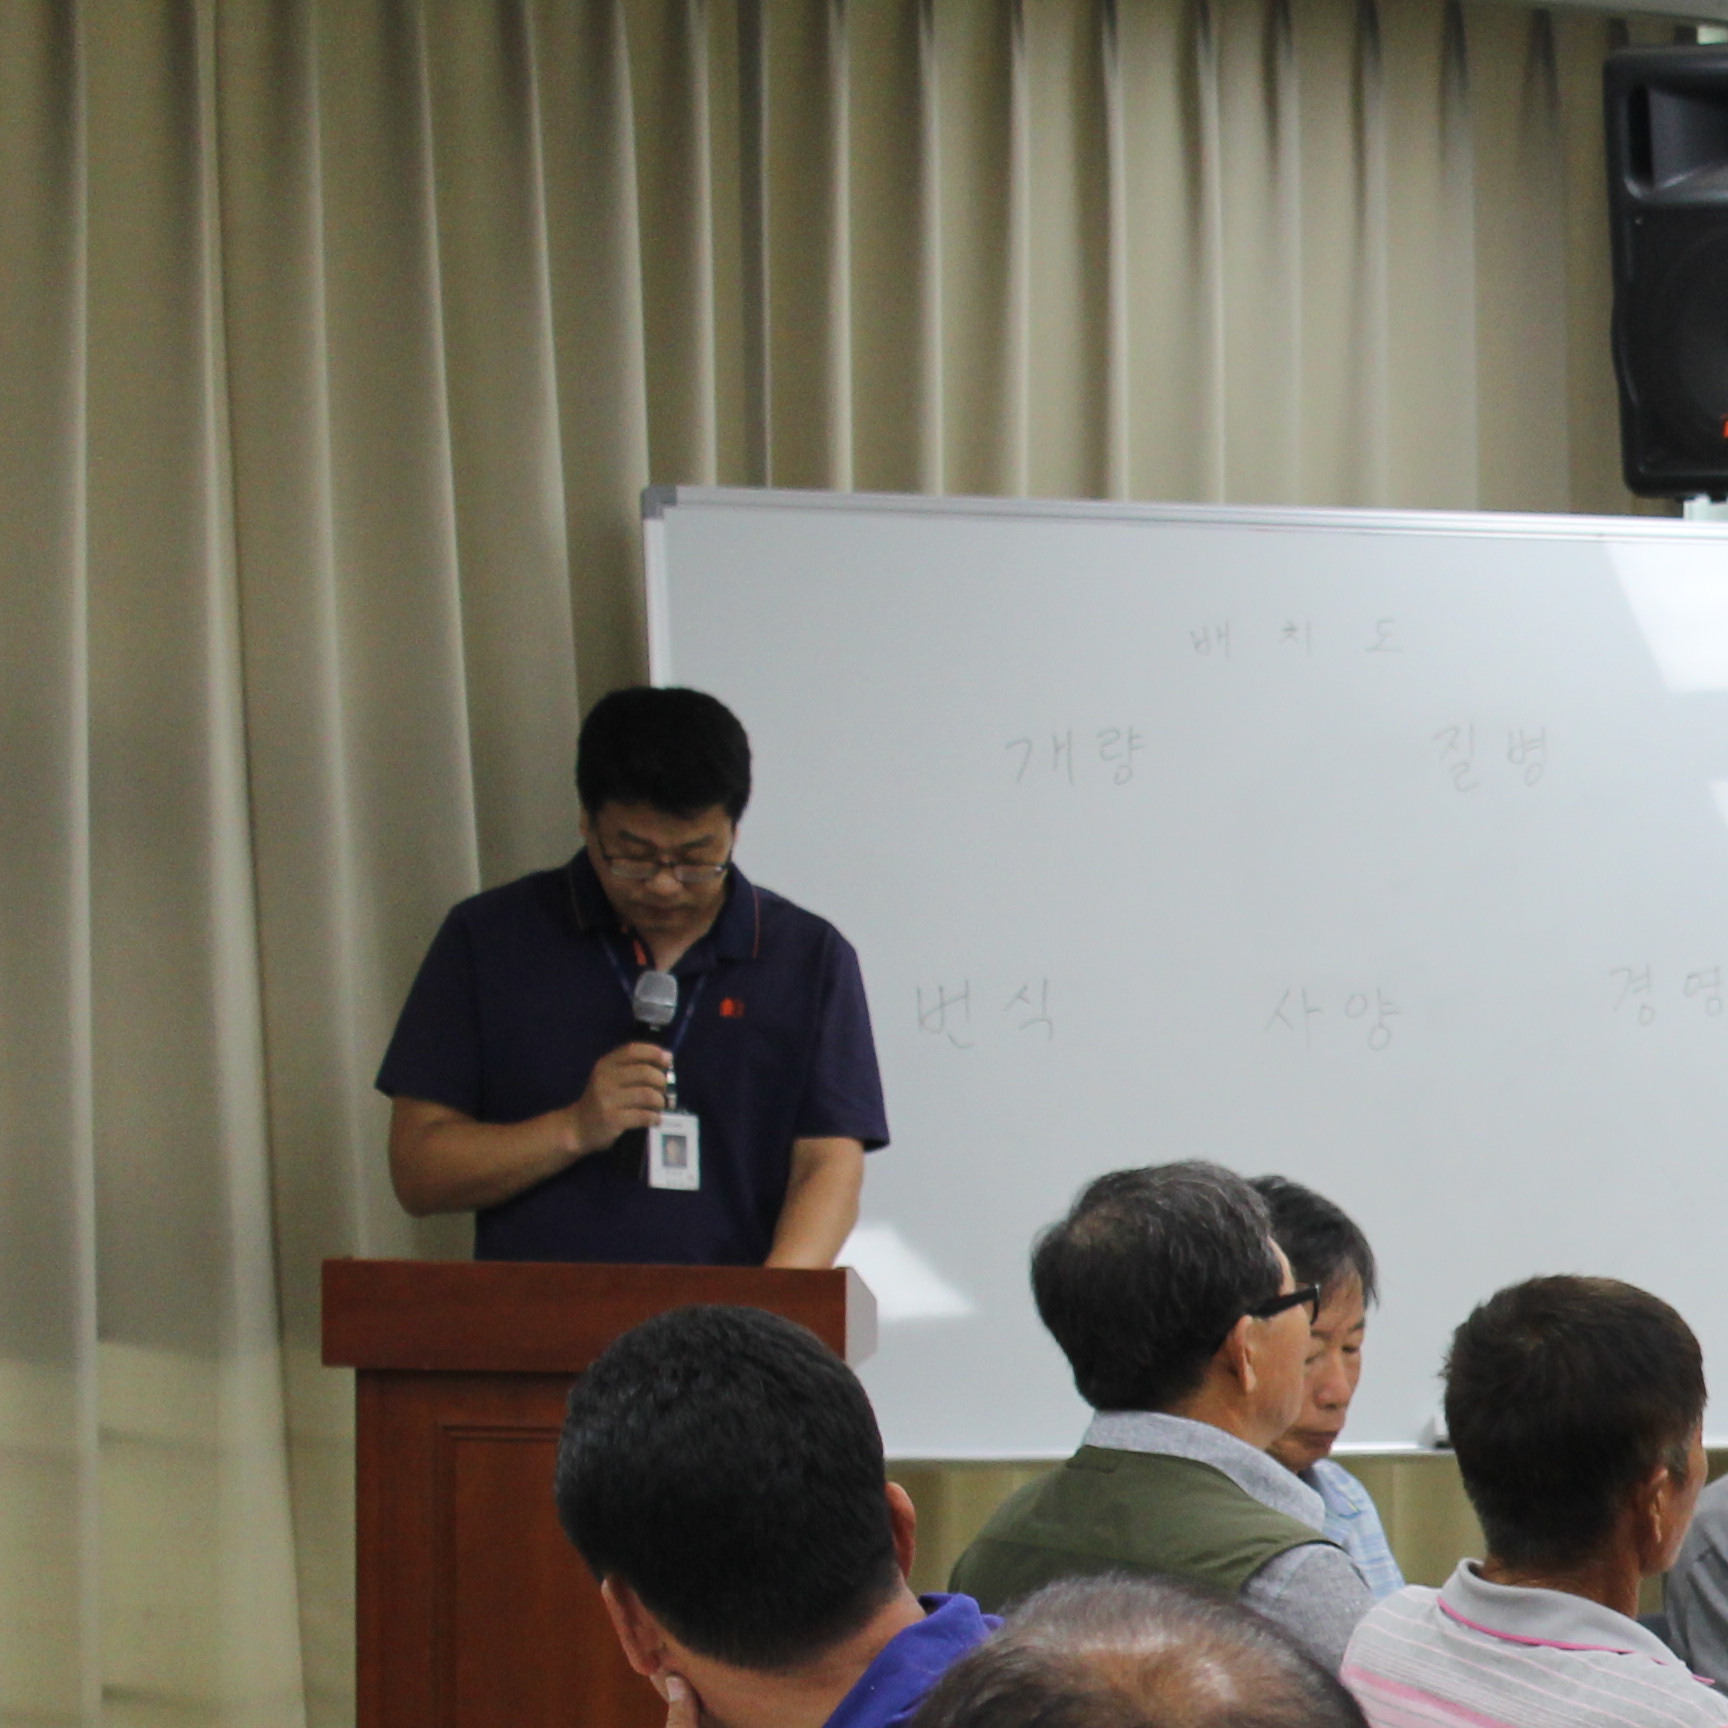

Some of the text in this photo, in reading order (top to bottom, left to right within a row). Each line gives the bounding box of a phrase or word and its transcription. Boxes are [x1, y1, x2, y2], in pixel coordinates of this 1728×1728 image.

[1432, 722, 1548, 794] 질병
[915, 977, 1055, 1051] 번식
[1264, 985, 1401, 1053] 사양
[1609, 963, 1722, 1026] 경영
